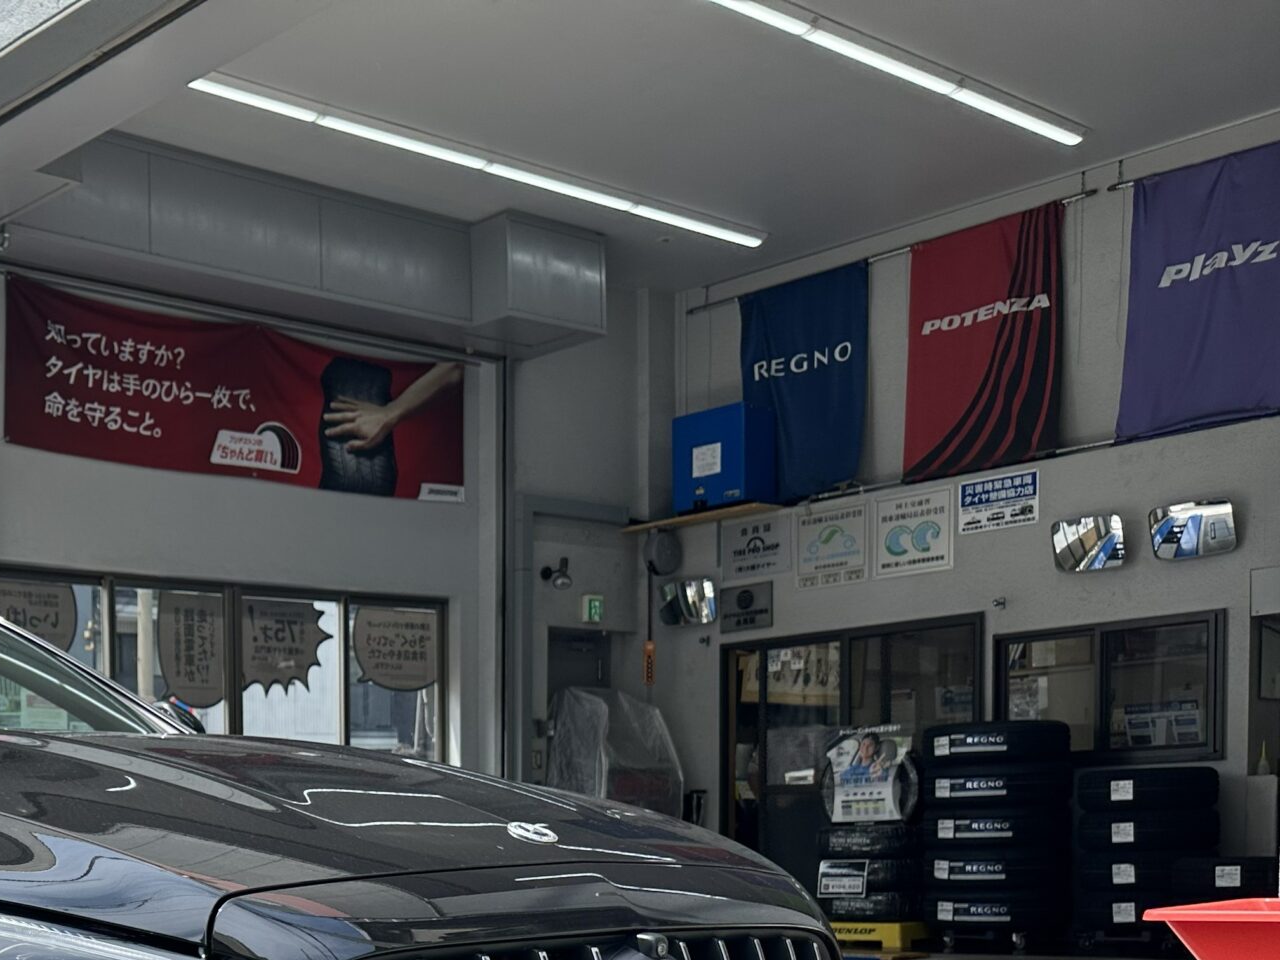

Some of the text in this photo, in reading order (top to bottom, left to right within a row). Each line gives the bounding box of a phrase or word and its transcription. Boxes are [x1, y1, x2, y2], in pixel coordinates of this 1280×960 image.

[1157, 240, 1280, 289] Playz
[921, 293, 1051, 336] POTENZA
[44, 319, 186, 371] 知っていますか?
[753, 341, 852, 381] REGNO
[44, 355, 258, 413] タイヤは手のひら一枚で、
[43, 391, 163, 439] 命を守ること。
[965, 735, 1005, 744] REGNO
[965, 780, 1004, 789] REGNO
[971, 821, 1010, 830] REGNO
[965, 864, 1003, 873] REGNO
[970, 905, 1008, 915] REGNO
